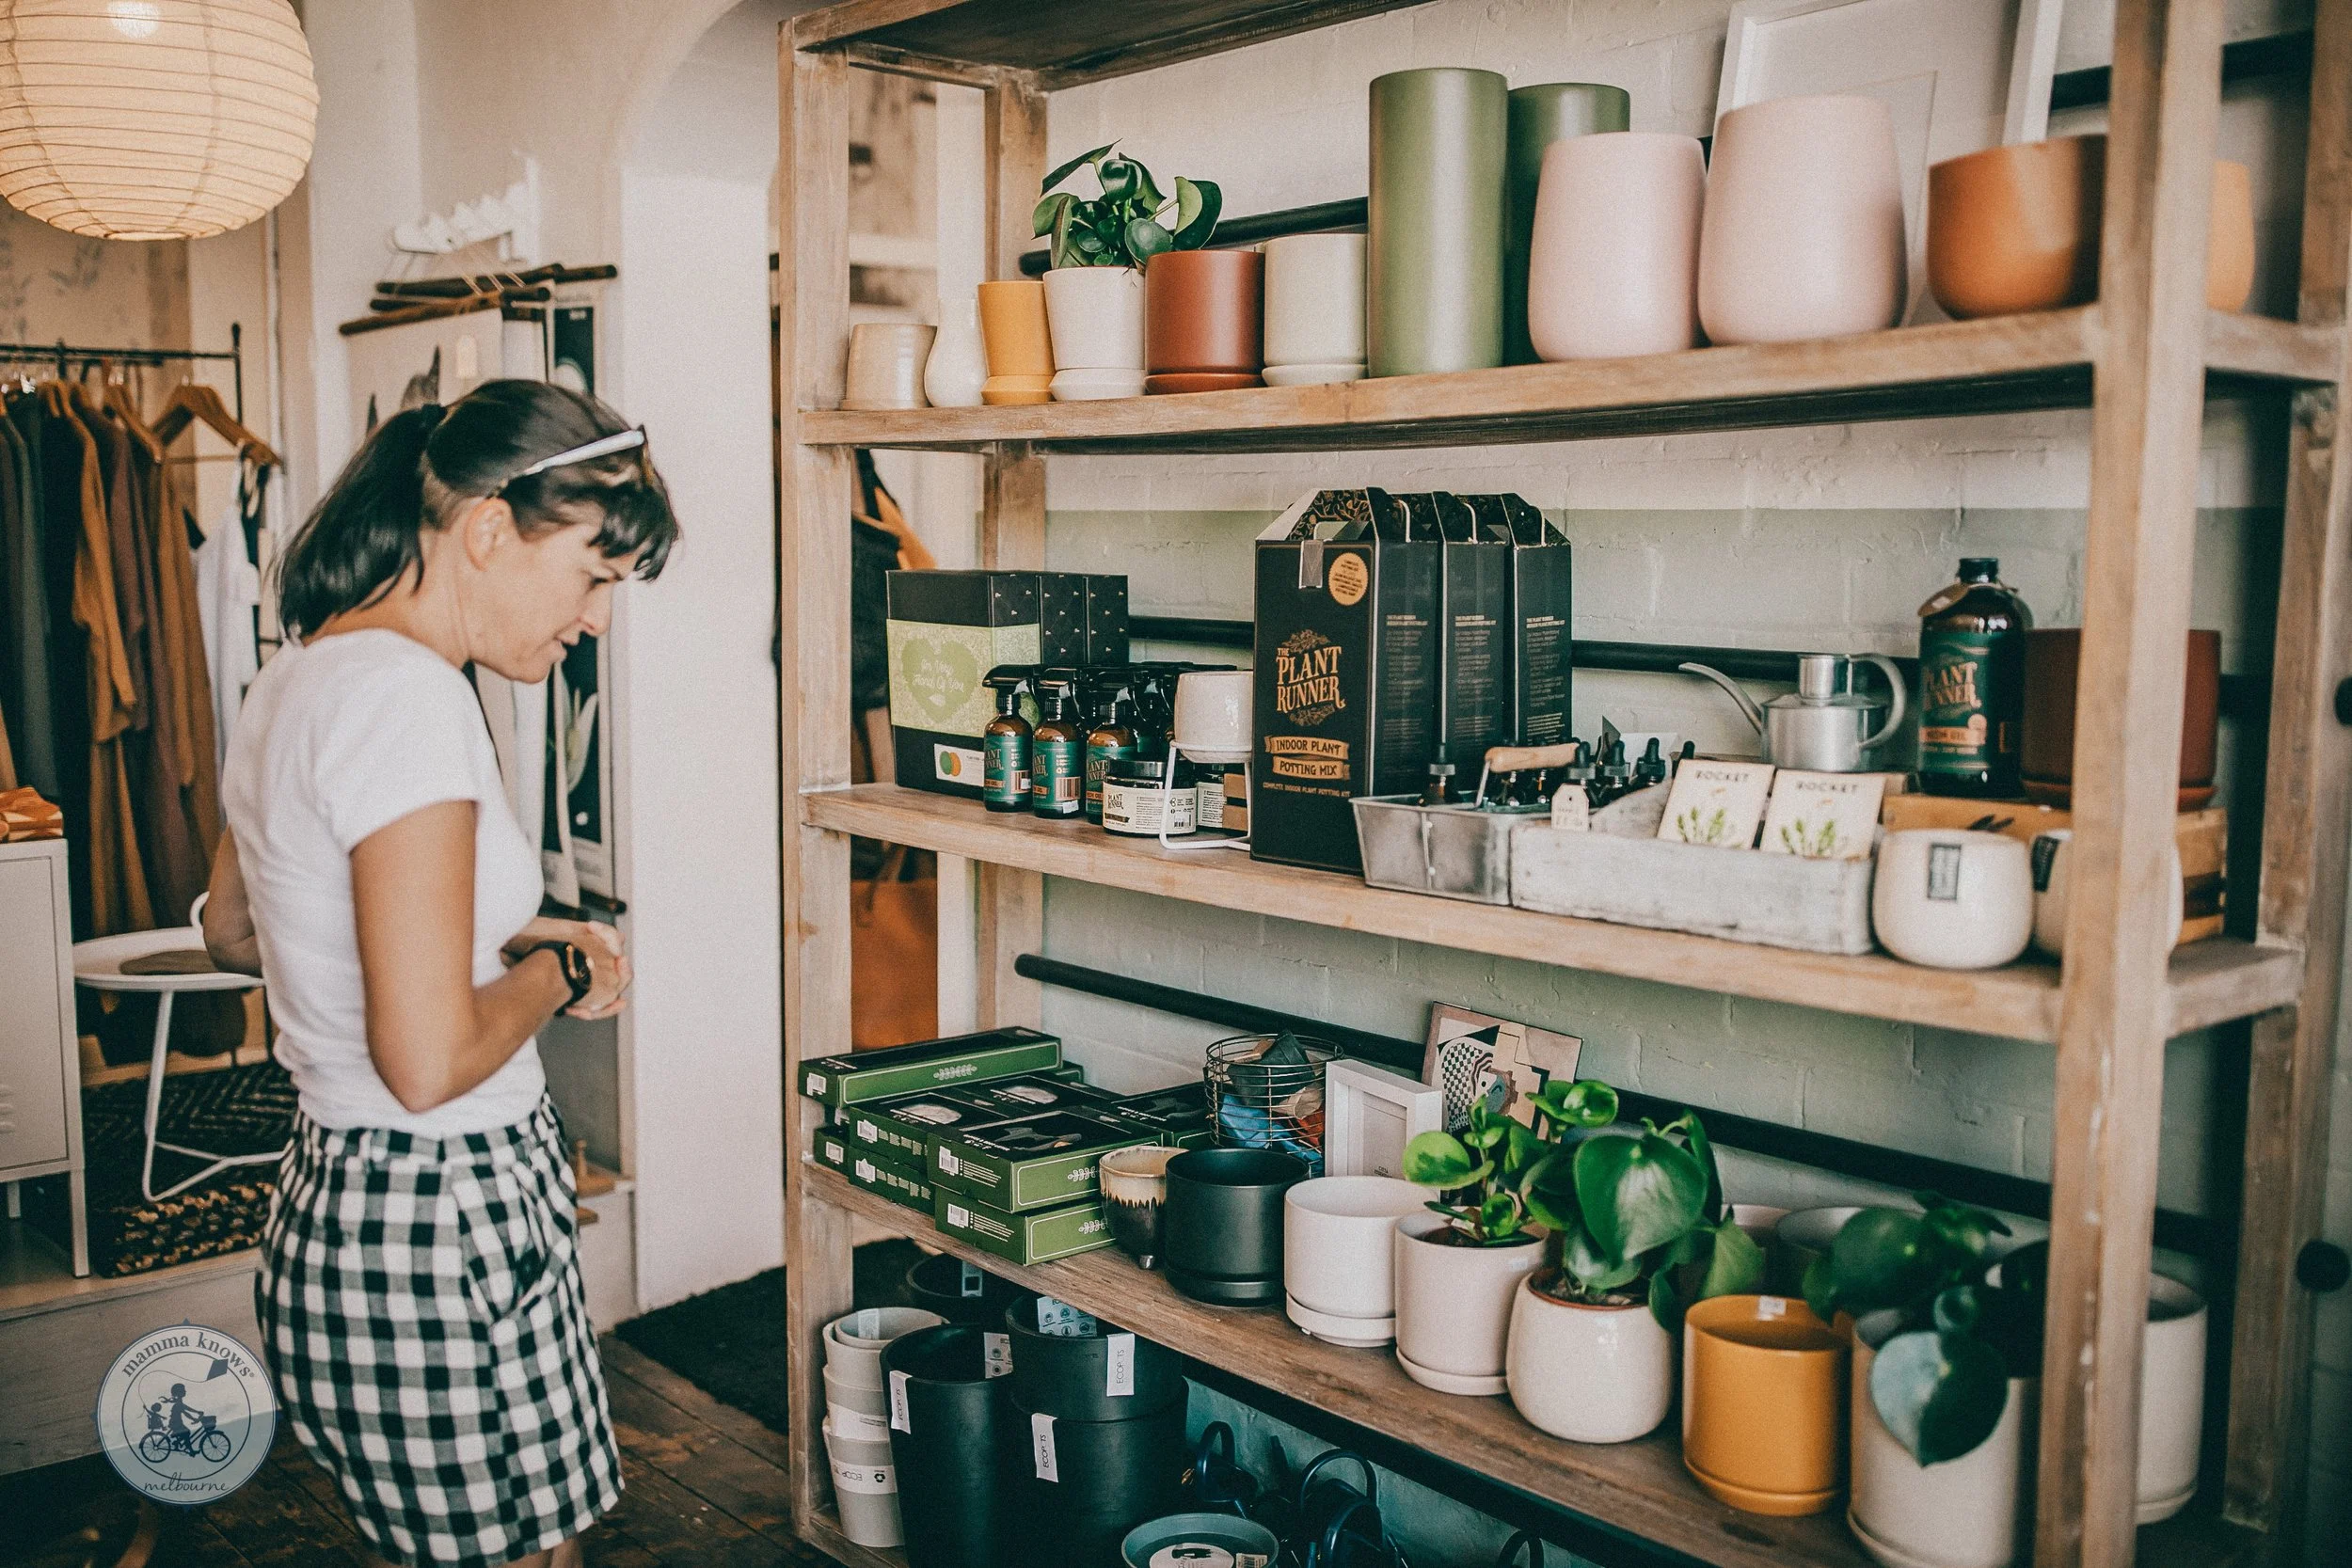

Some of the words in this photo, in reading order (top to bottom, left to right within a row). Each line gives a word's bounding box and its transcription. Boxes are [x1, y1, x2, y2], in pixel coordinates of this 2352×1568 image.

[1278, 647, 1289, 656] THE
[1276, 646, 1342, 685] PLANT
[1277, 675, 1346, 713] RUNNER
[1276, 739, 1308, 751] INDOOR
[1311, 740, 1342, 754] PLANT
[1279, 760, 1316, 775] POTTING
[1319, 764, 1338, 776] MIX
[1695, 769, 1750, 783] ROCKET
[1797, 780, 1858, 793] ROCKET
[1116, 1349, 1125, 1384] ECOPTS
[1040, 1434, 1049, 1468] ECOPTS
